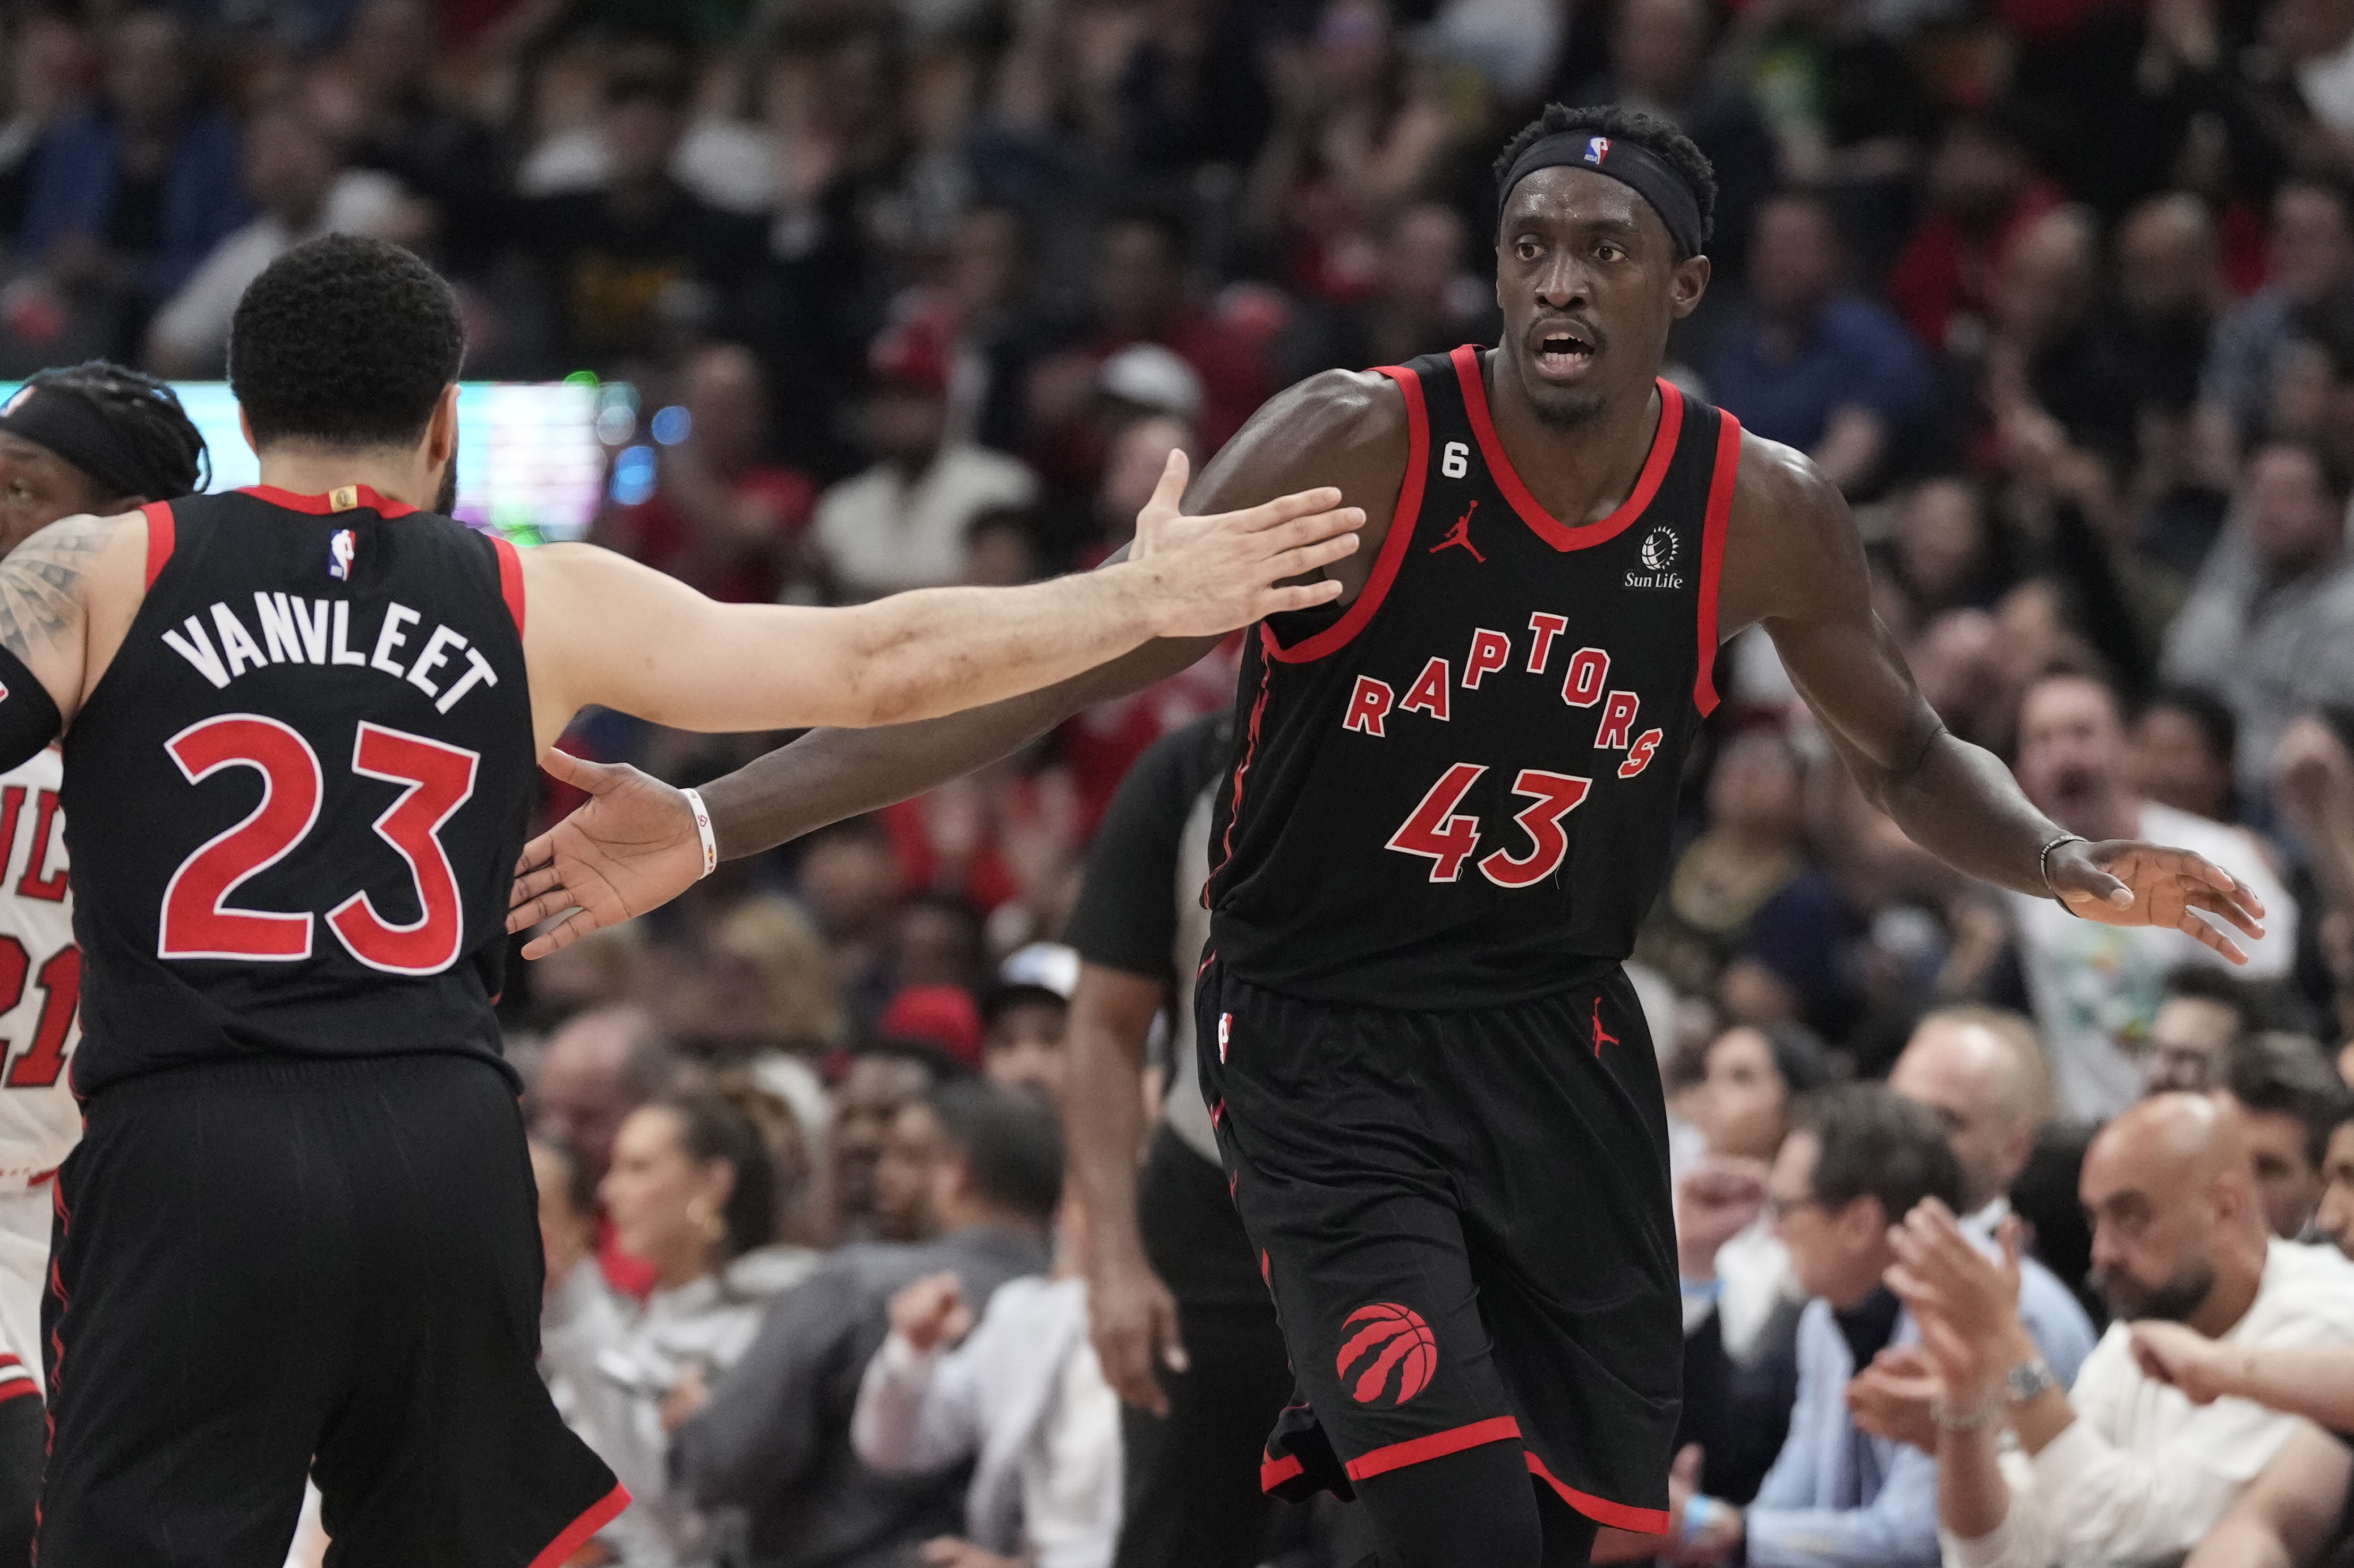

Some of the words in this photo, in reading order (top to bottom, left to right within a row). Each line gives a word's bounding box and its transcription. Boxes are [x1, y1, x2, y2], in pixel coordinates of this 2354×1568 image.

[1442, 441, 1469, 479] 6
[1625, 572, 1652, 587] Sun
[1655, 573, 1683, 589] Life
[161, 591, 498, 714] VANVLEET
[1342, 611, 1662, 778] RAPTORS
[158, 712, 480, 975] 23
[1385, 762, 1592, 888] 43
